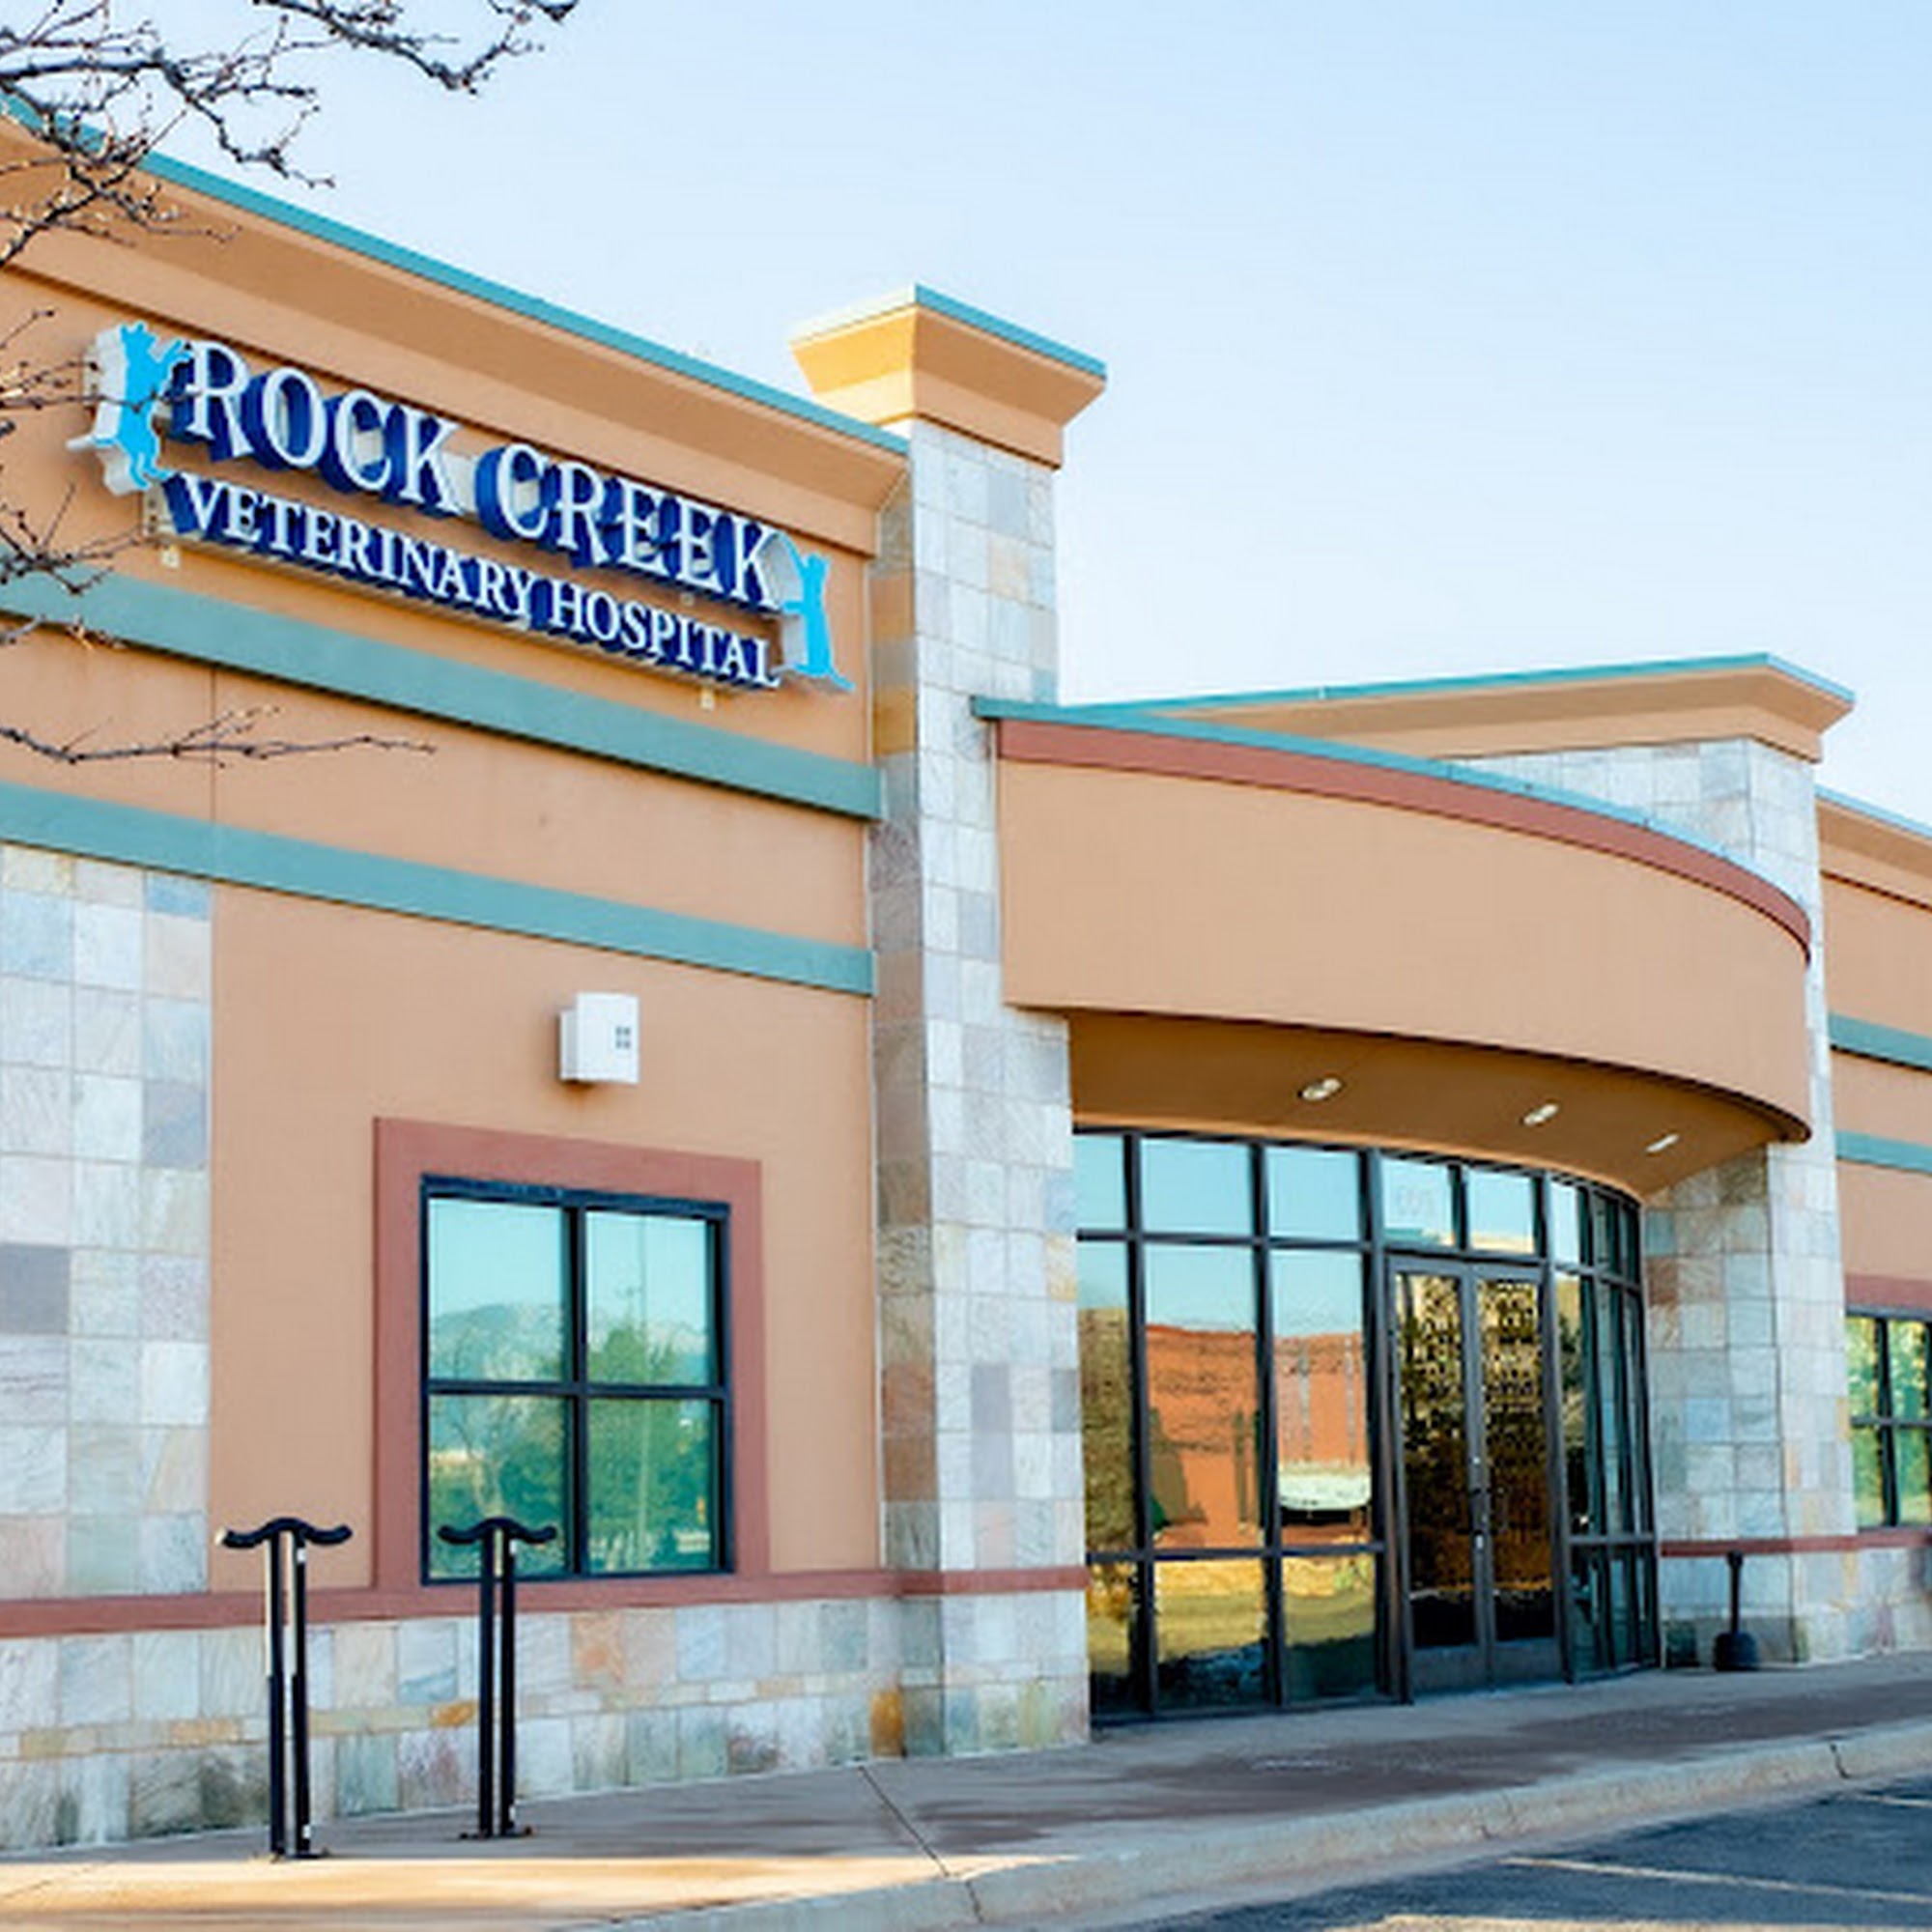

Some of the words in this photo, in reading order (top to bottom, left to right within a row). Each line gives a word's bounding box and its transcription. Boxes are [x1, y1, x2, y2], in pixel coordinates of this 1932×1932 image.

[178, 472, 536, 617] VETERINARY
[549, 578, 781, 689] HOSPITAL
[185, 340, 464, 516] ROCK
[496, 442, 781, 611] CREEK
